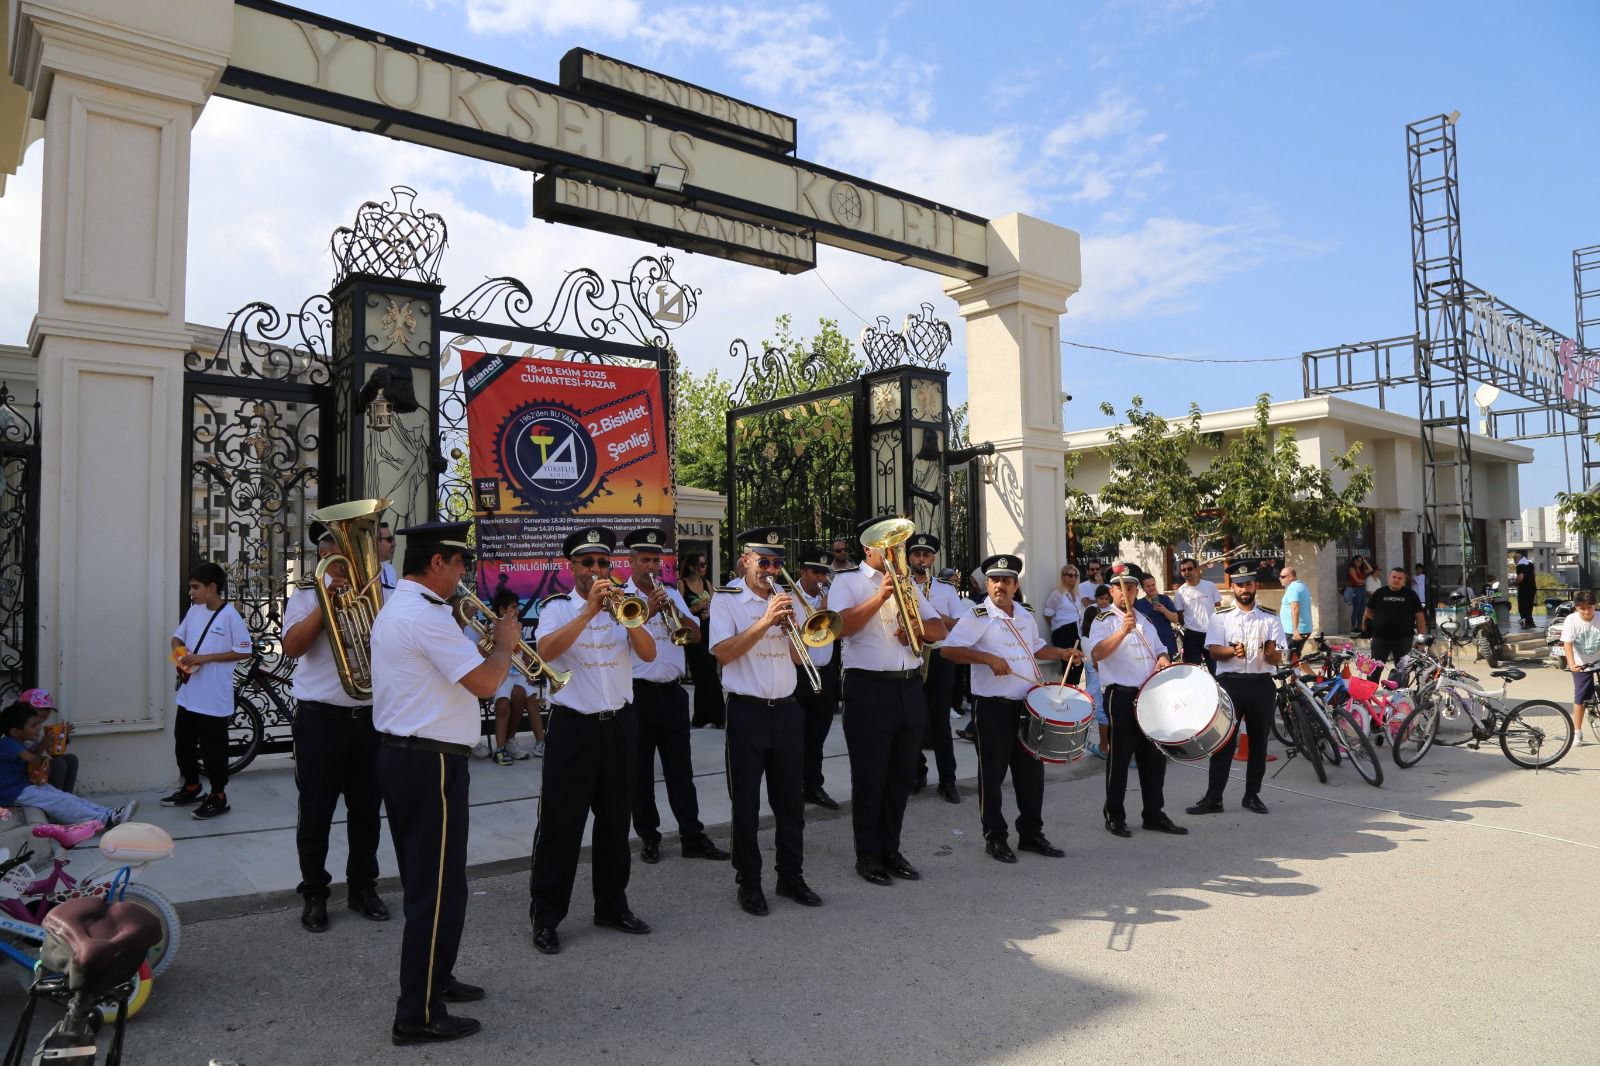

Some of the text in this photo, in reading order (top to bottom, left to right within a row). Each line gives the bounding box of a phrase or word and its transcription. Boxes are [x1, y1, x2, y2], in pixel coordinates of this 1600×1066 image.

[590, 52, 789, 142] İSKENDERUN
[563, 178, 813, 261] BİLİM KAMPÜSÜ
[791, 165, 961, 257] KOLEJİ
[467, 356, 503, 388] Bianchi
[520, 373, 617, 390] CUMARTESİ-PAZAR
[525, 364, 607, 380] 18-19 EKİM 2025
[519, 409, 579, 430] 1962'den BU YANA
[678, 520, 714, 537] NLİK
